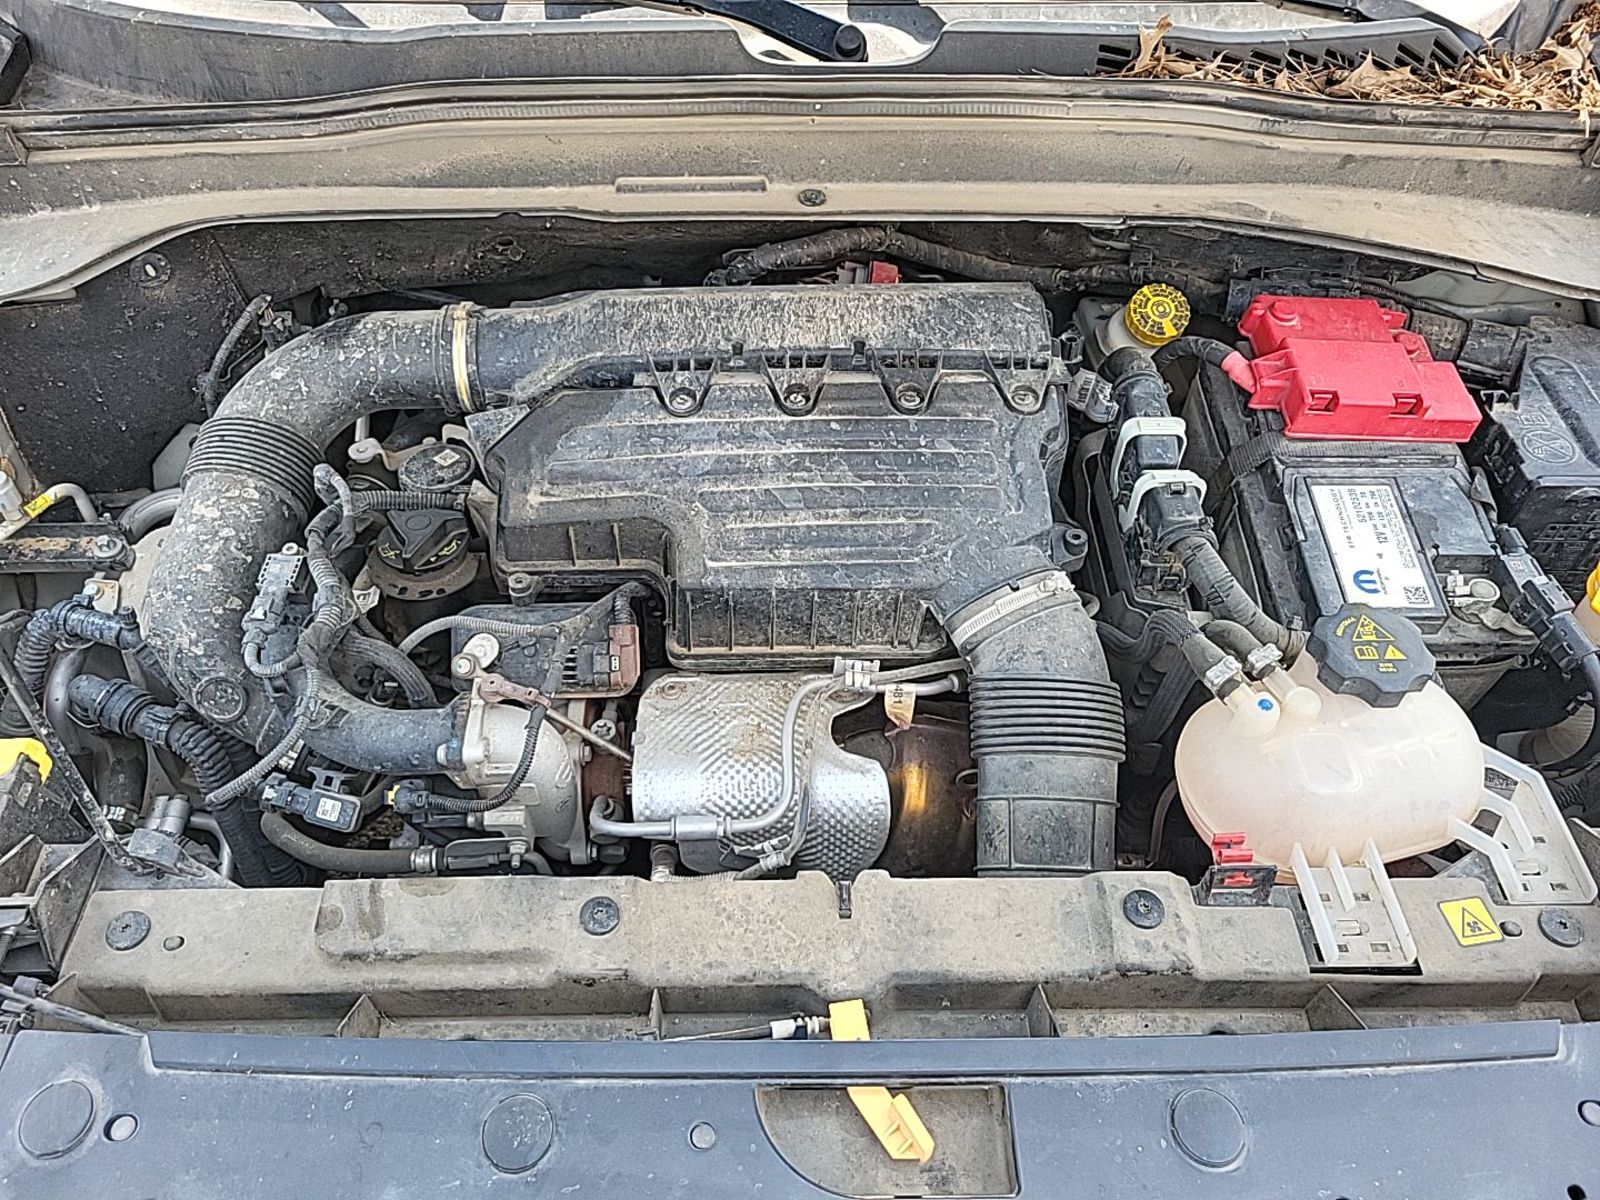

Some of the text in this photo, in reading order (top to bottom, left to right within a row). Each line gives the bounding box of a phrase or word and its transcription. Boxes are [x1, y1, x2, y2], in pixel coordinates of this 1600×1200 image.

[1329, 488, 1350, 533] TECHNOLOGY
[1374, 531, 1389, 544] 12V
[892, 682, 904, 705] 481
